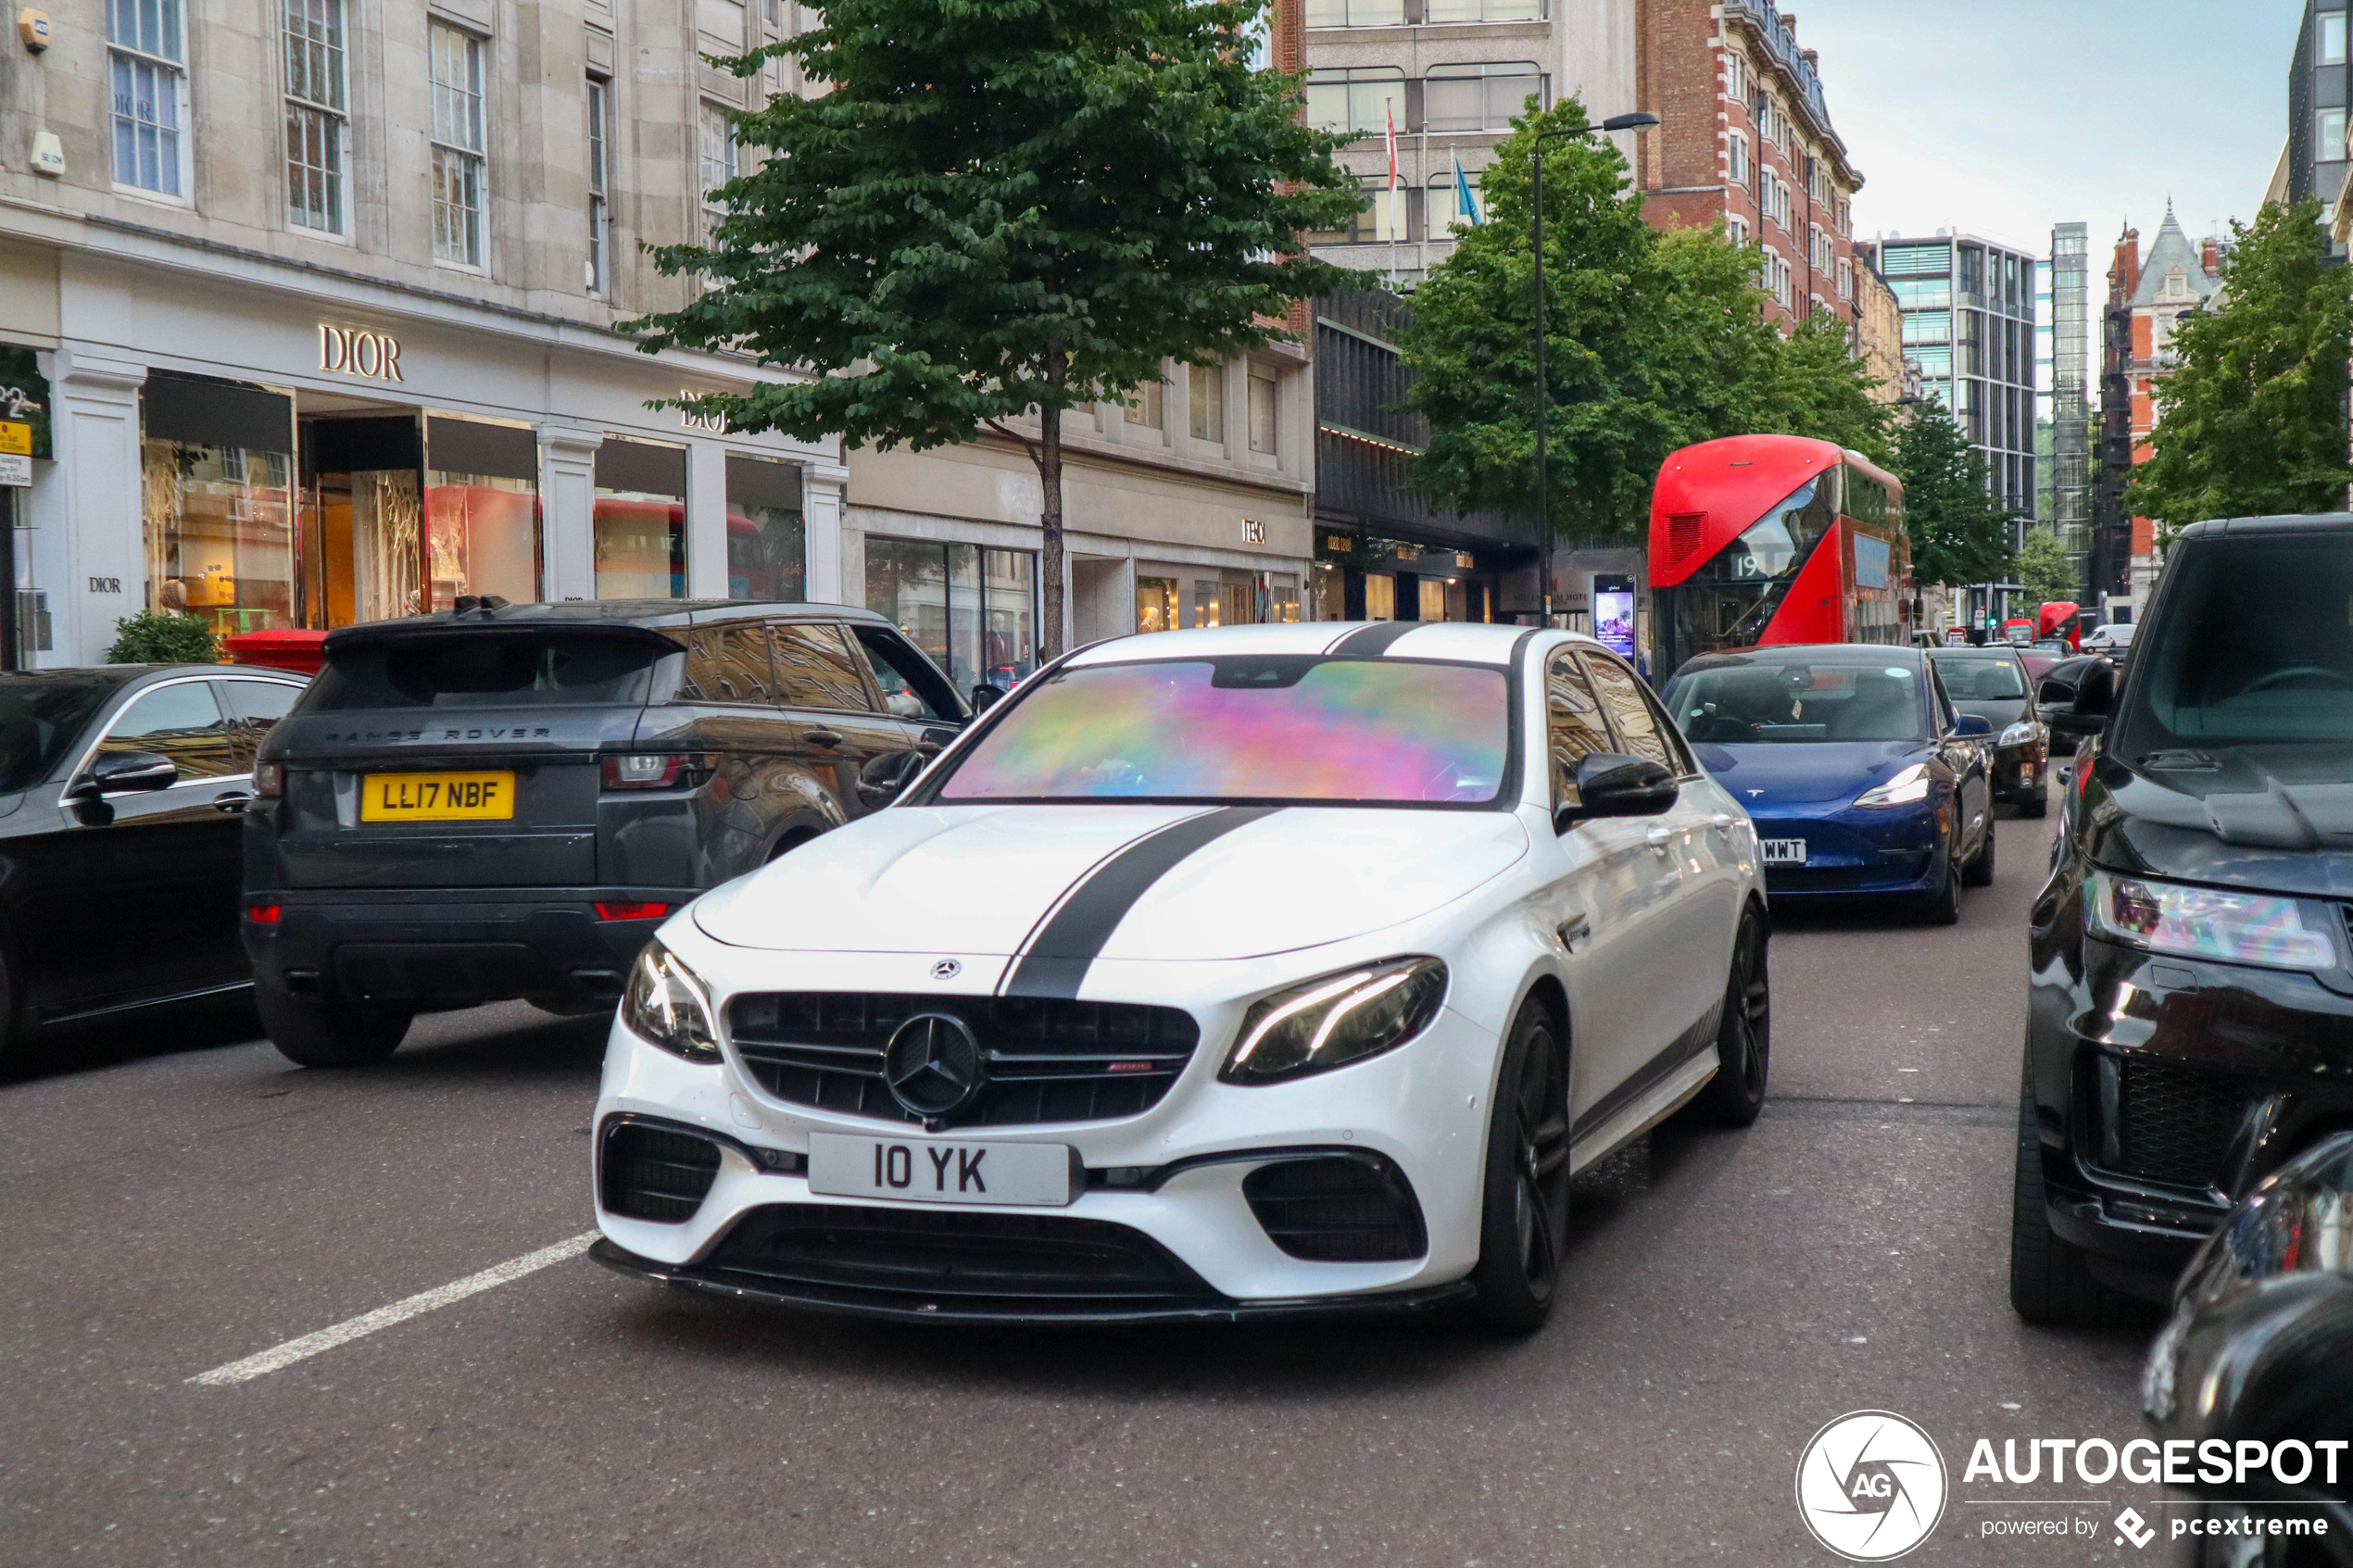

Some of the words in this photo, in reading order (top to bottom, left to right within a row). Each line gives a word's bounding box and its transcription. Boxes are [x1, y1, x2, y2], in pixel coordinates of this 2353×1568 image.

[318, 322, 405, 383] DIOR
[681, 389, 736, 435] DO
[1738, 556, 1758, 577] 19
[89, 576, 121, 594] DIOR
[1514, 594, 1564, 602] MILLENUM
[1567, 593, 1588, 601] HOTE
[326, 730, 422, 741] RANGE
[445, 728, 550, 740] ROVER
[383, 782, 440, 809] LL17
[447, 781, 498, 808] NBF
[1765, 841, 1801, 859] WWT
[875, 1143, 912, 1189] 10
[927, 1147, 987, 1193] YK
